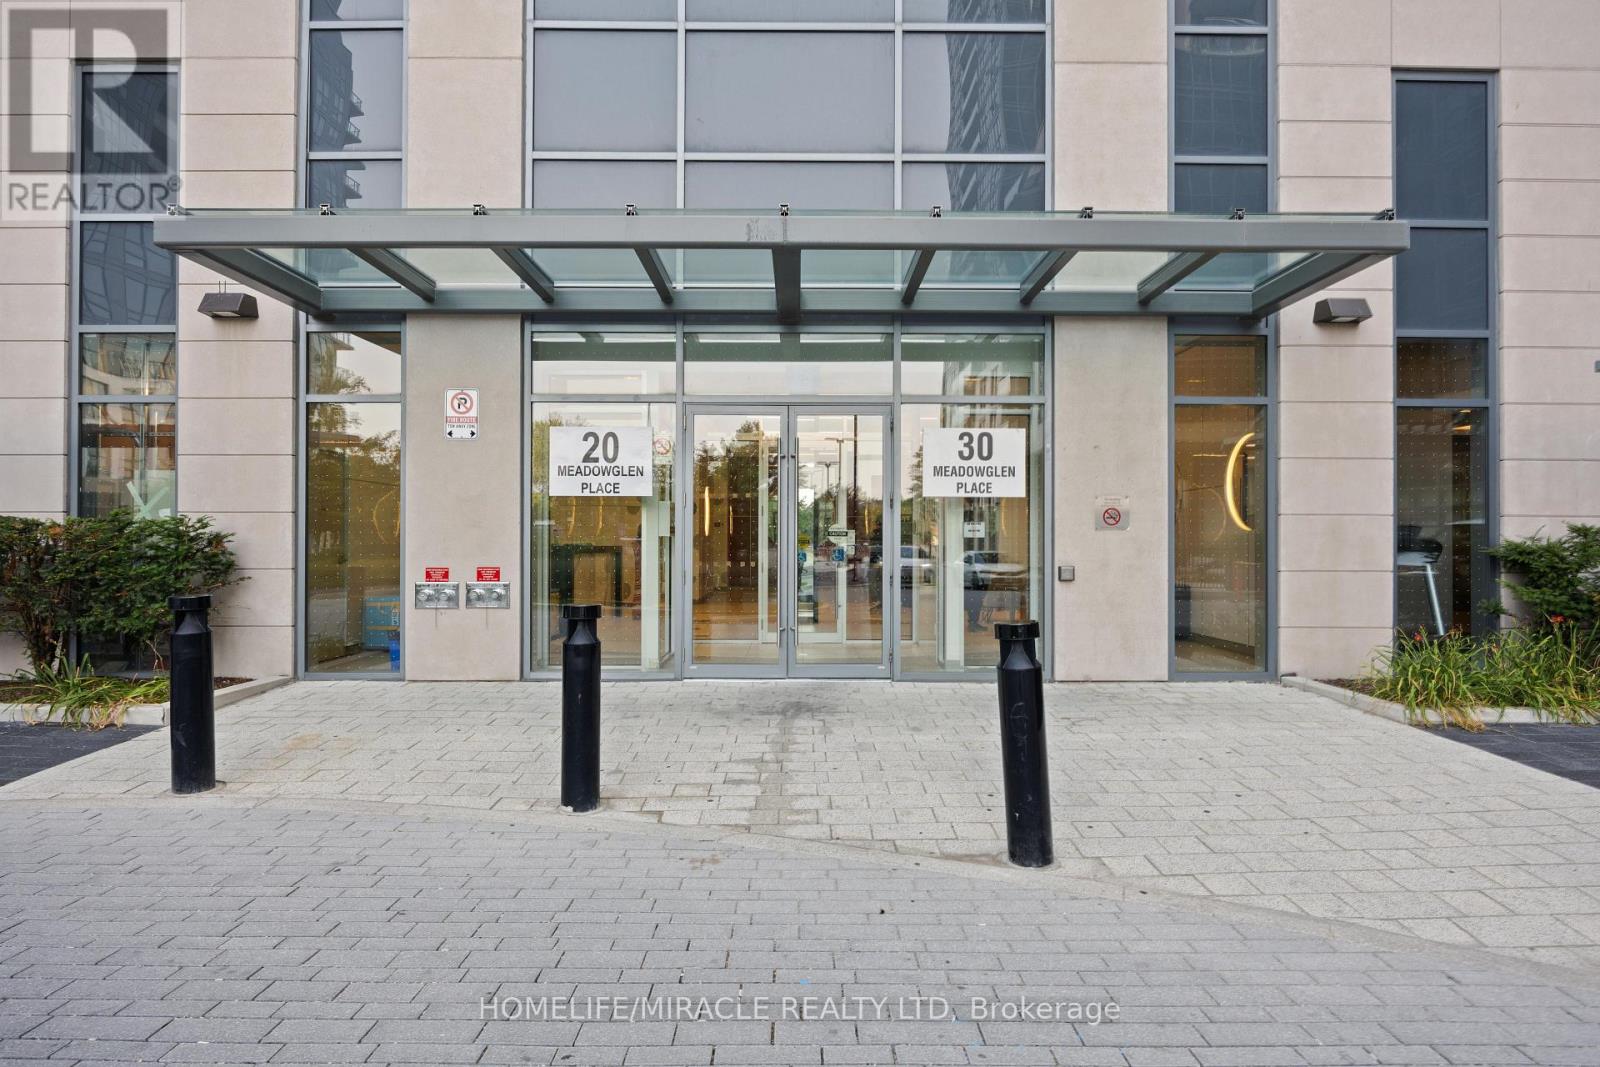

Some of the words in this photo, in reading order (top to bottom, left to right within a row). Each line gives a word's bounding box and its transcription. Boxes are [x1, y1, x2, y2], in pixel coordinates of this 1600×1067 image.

[581, 431, 619, 463] 20
[958, 431, 993, 461] 30
[557, 465, 644, 477] MEADOWGLEN
[933, 465, 1016, 477] MEADOWGLEN
[581, 482, 620, 494] PLACE
[956, 482, 992, 494] PLACE
